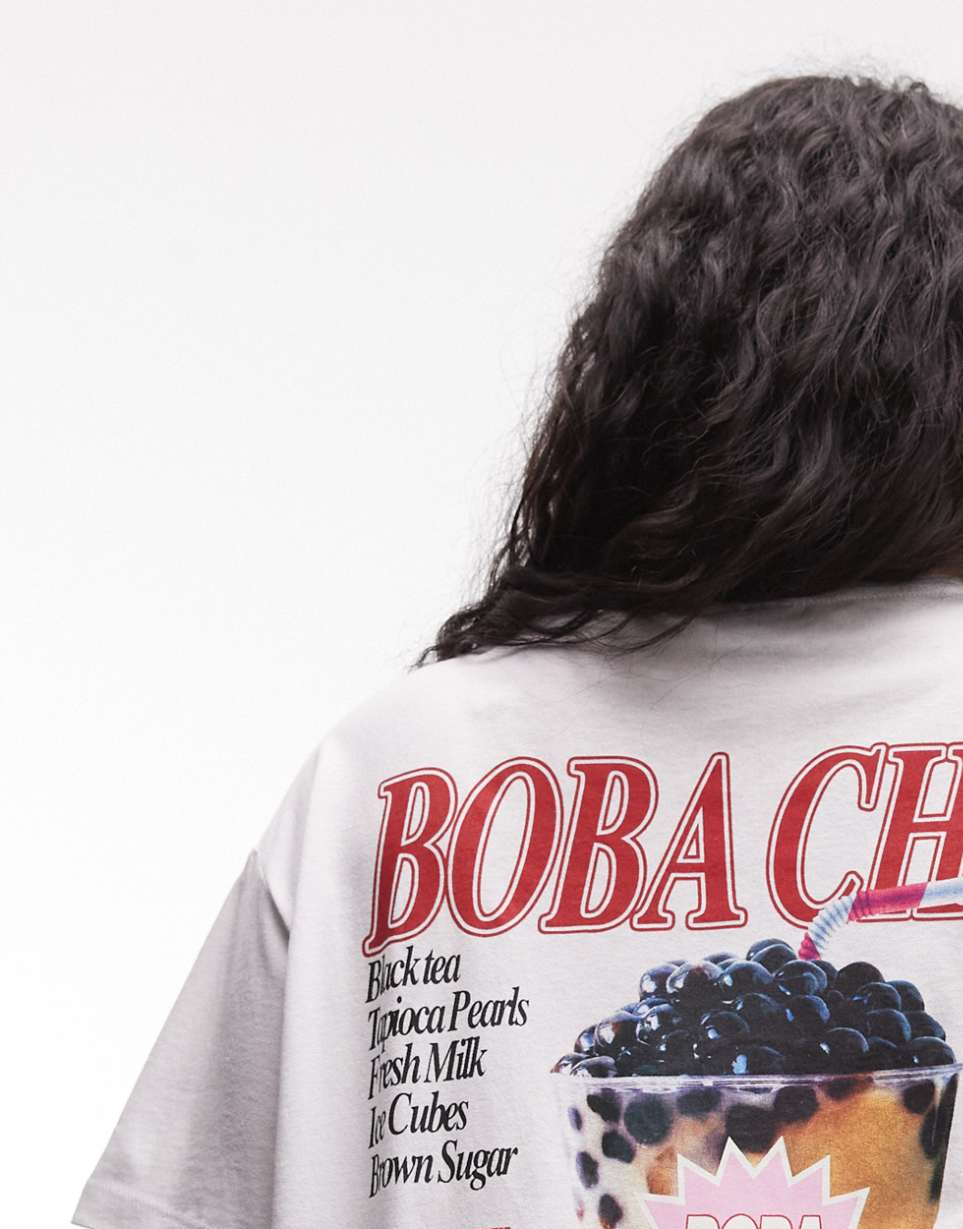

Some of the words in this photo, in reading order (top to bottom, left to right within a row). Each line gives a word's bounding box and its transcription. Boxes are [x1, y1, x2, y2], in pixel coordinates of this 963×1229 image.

[363, 752, 748, 957] BOBA
[423, 950, 461, 985] tea
[447, 987, 530, 1032] Pearls
[368, 1044, 420, 1100] Fresh
[424, 1036, 488, 1083] Milk
[388, 1091, 469, 1136] Cubes
[369, 1154, 434, 1198] Brown
[437, 1140, 518, 1191] Sugar
